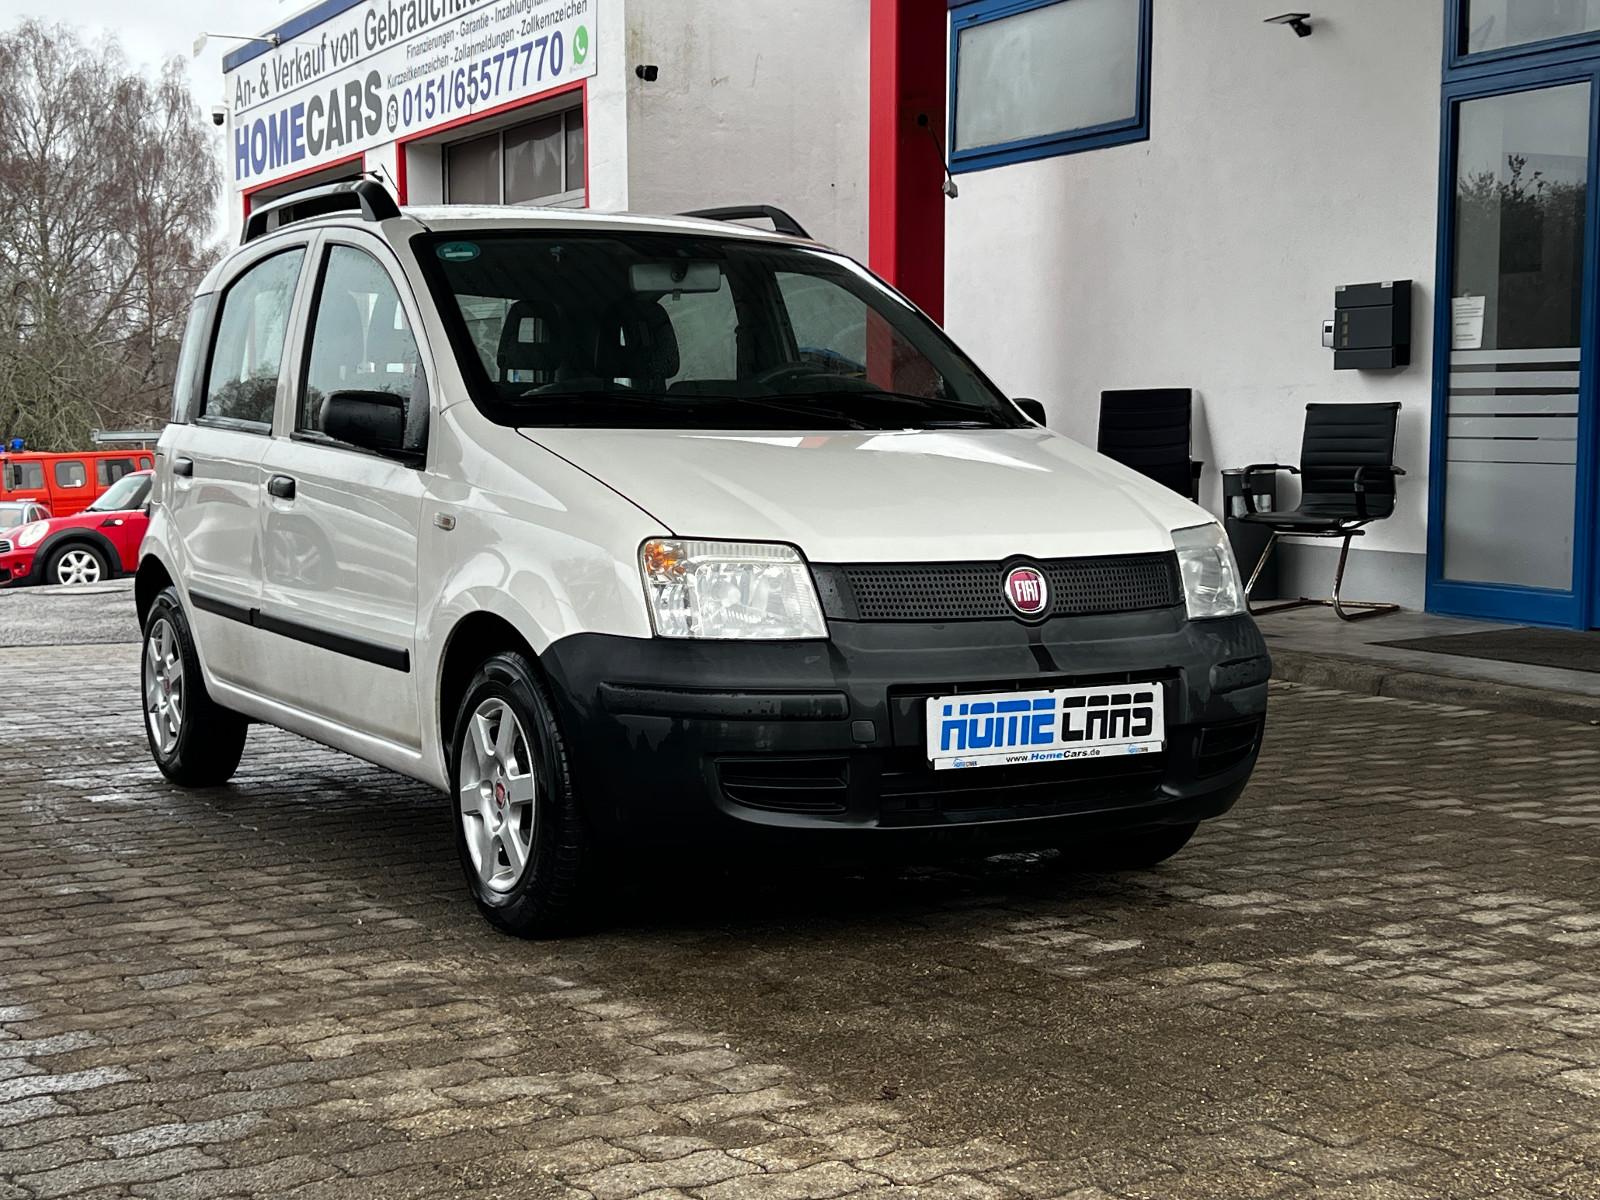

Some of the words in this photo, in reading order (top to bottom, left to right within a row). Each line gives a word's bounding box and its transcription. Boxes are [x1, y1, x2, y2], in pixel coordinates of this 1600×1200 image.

[387, 54, 449, 89] Kurzzeitkennzeichen
[454, 28, 514, 62] Zollanmeldungen
[521, 0, 587, 36] Zollkennzeichen
[406, 29, 455, 59] Finanzierungen
[460, 13, 489, 37] Garantie
[235, 75, 256, 110] An-
[260, 62, 269, 99] &
[273, 32, 327, 93] Verkauf
[331, 28, 359, 67] von
[235, 70, 383, 181] HOMECARS
[403, 30, 563, 127] 0151/65577770
[1013, 579, 1039, 602] FIAT
[1005, 748, 1101, 763] www.HomeCars.de
